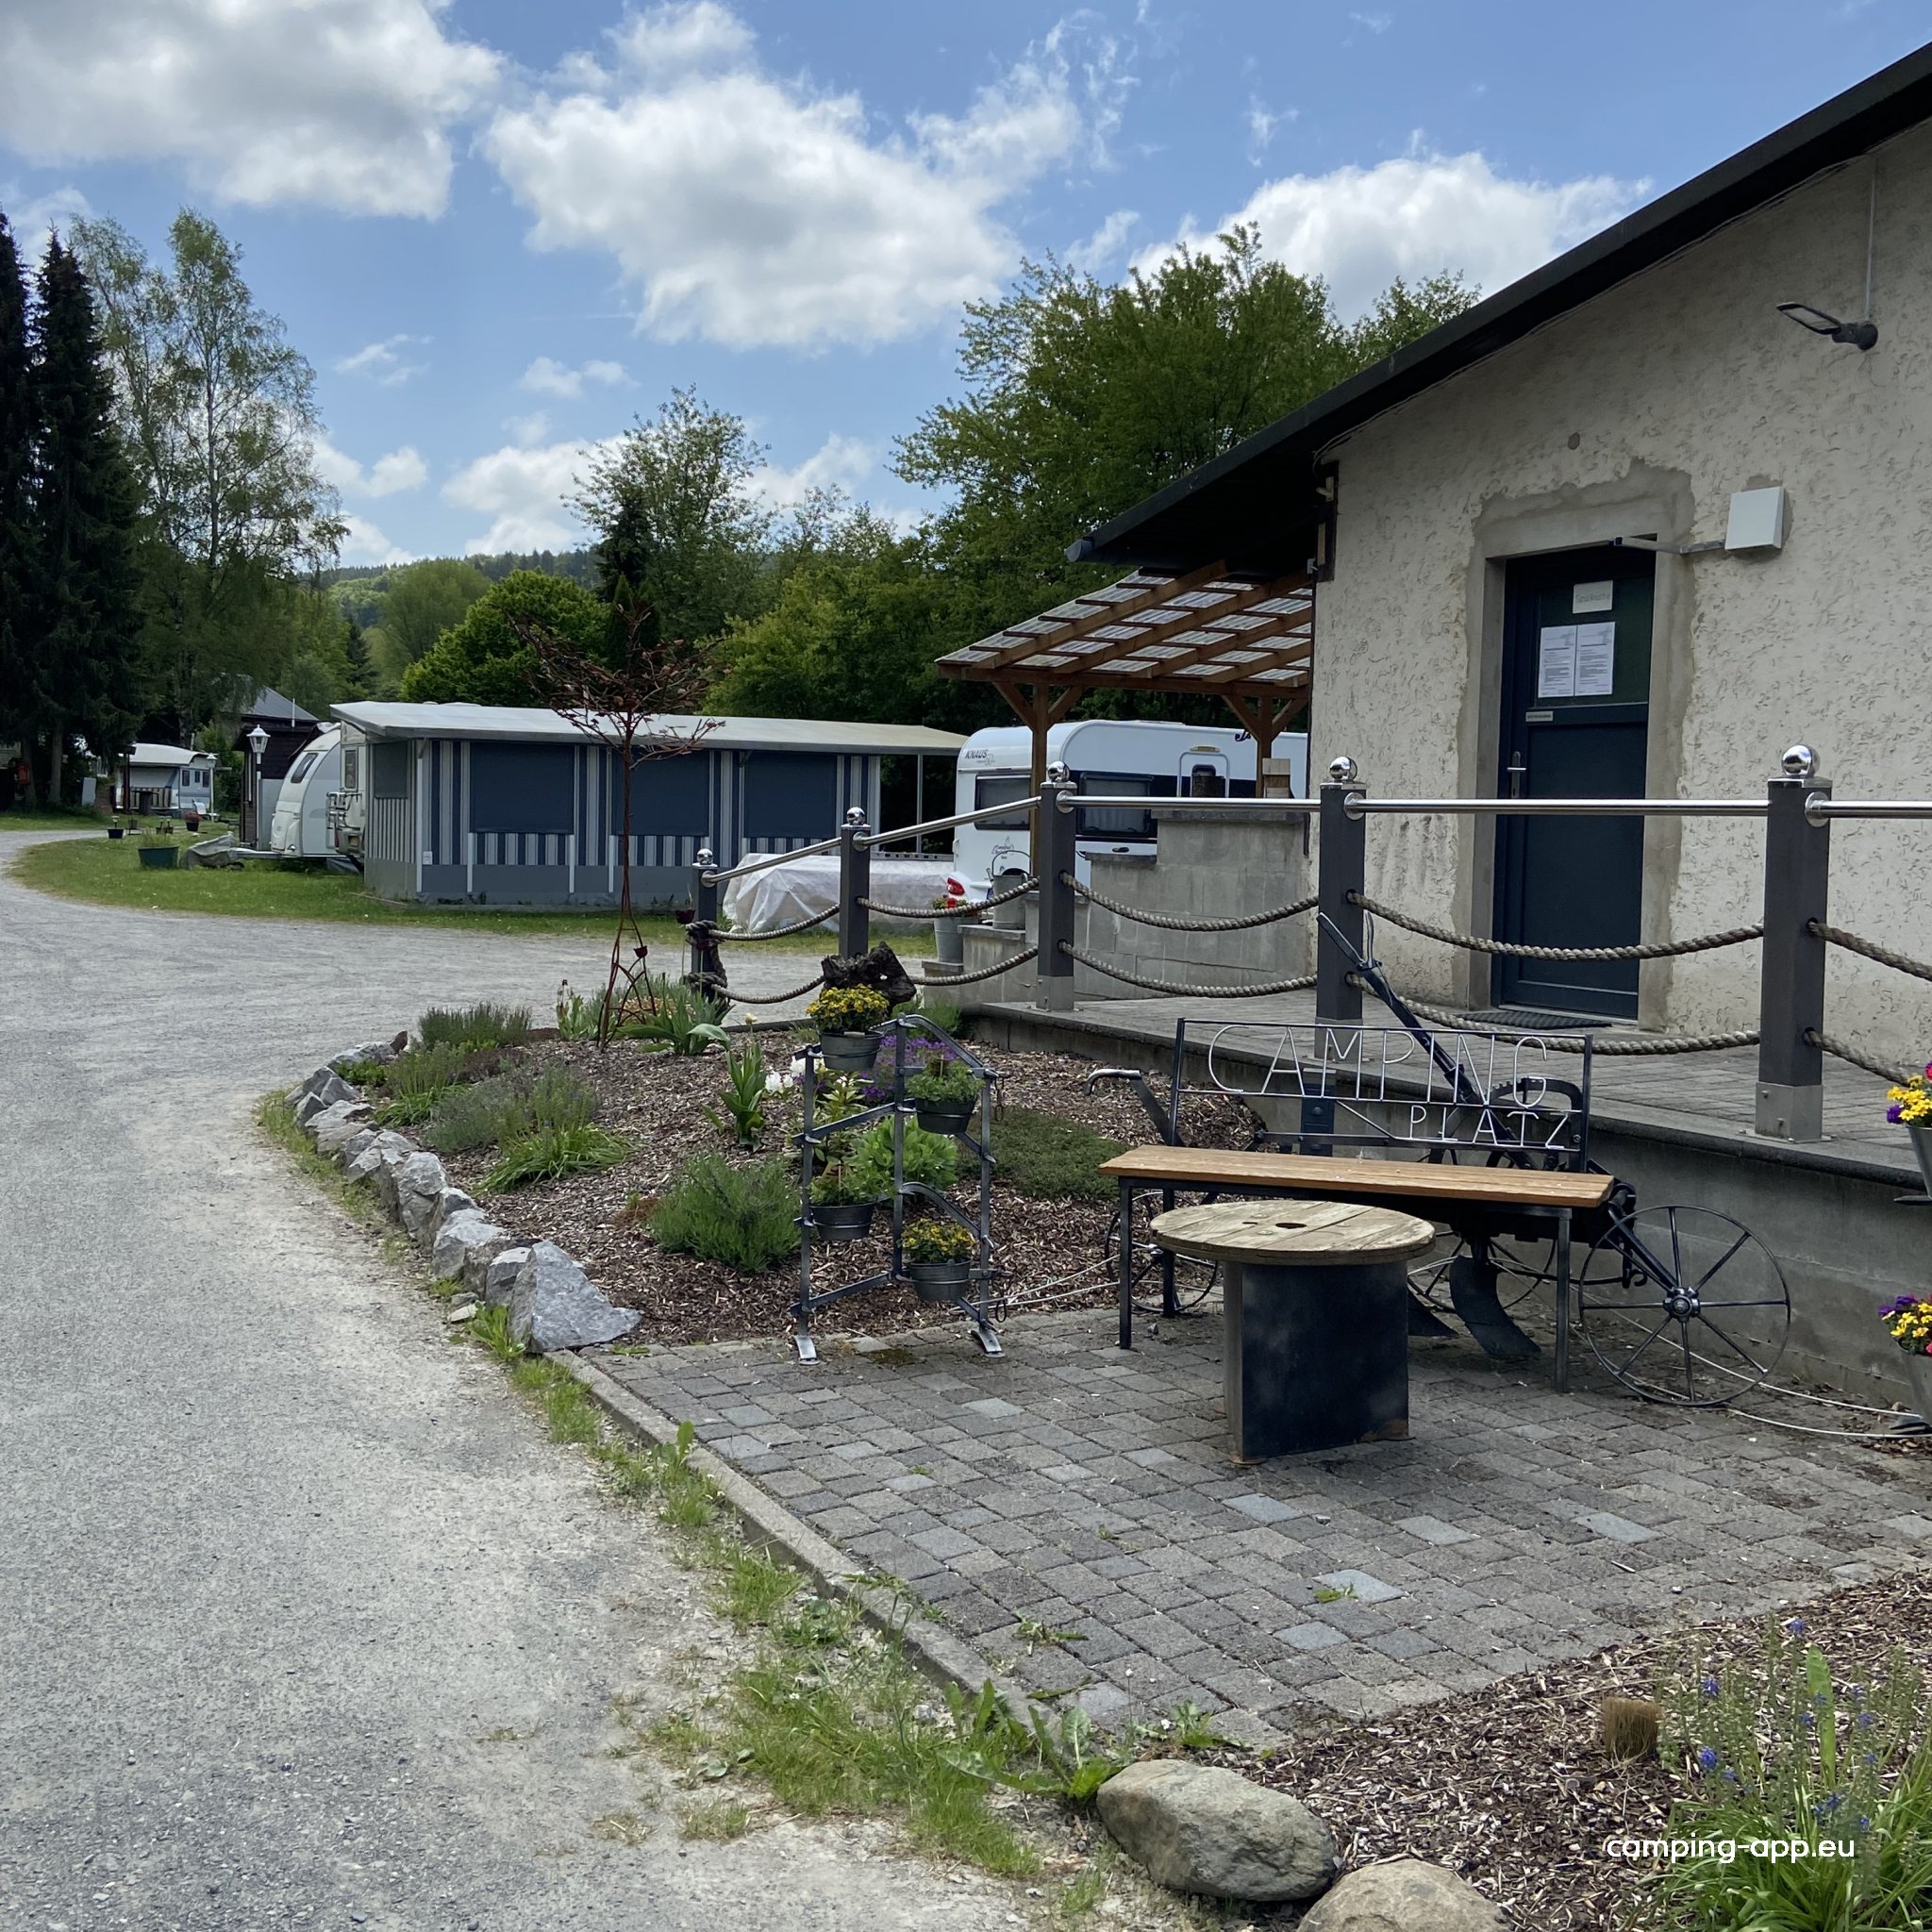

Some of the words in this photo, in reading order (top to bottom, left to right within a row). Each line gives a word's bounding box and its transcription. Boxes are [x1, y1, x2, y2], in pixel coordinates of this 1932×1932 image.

[964, 749, 989, 759] KNAUS
[1208, 1024, 1548, 1108] CAMPING
[1409, 1105, 1570, 1149] PLATZ
